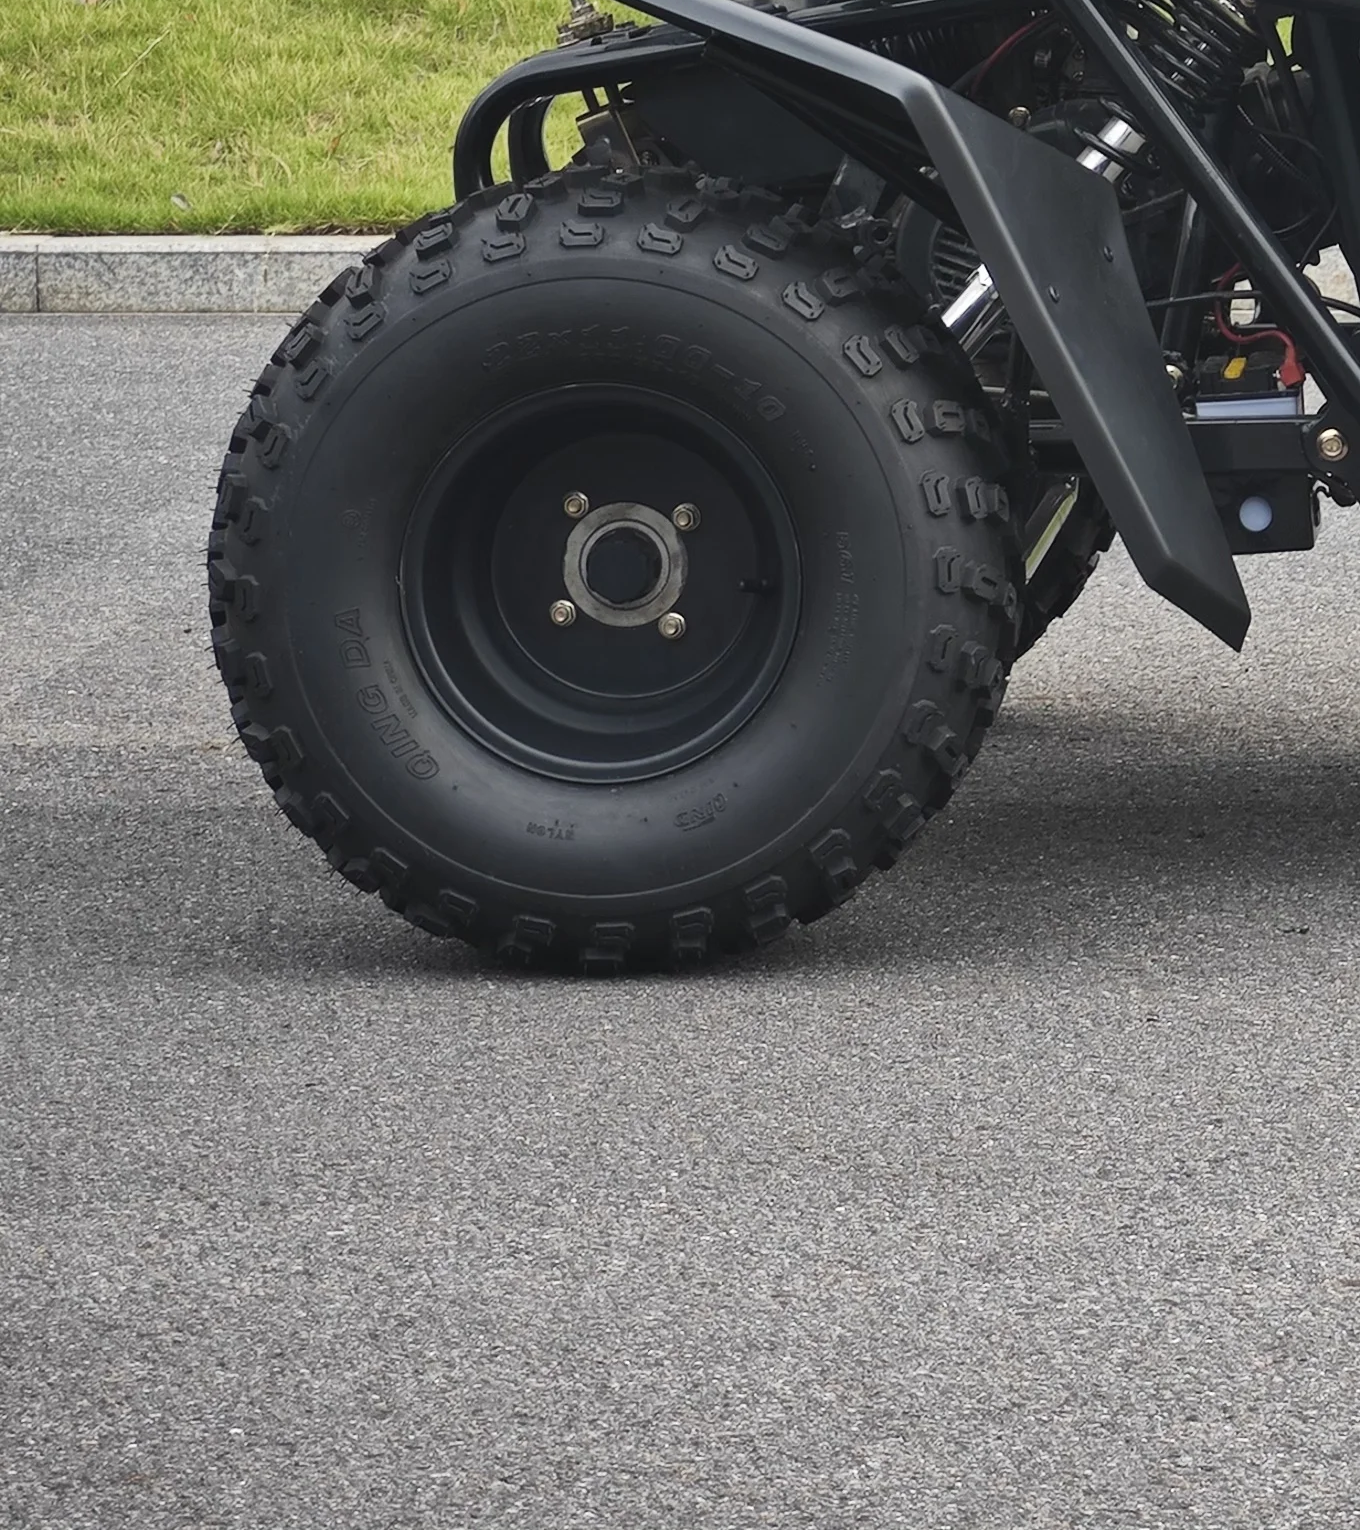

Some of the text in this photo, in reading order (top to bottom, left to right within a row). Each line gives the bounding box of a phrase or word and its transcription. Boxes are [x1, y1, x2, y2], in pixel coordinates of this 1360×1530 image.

[334, 606, 440, 781] QING DA
[526, 821, 576, 840] NYLON
